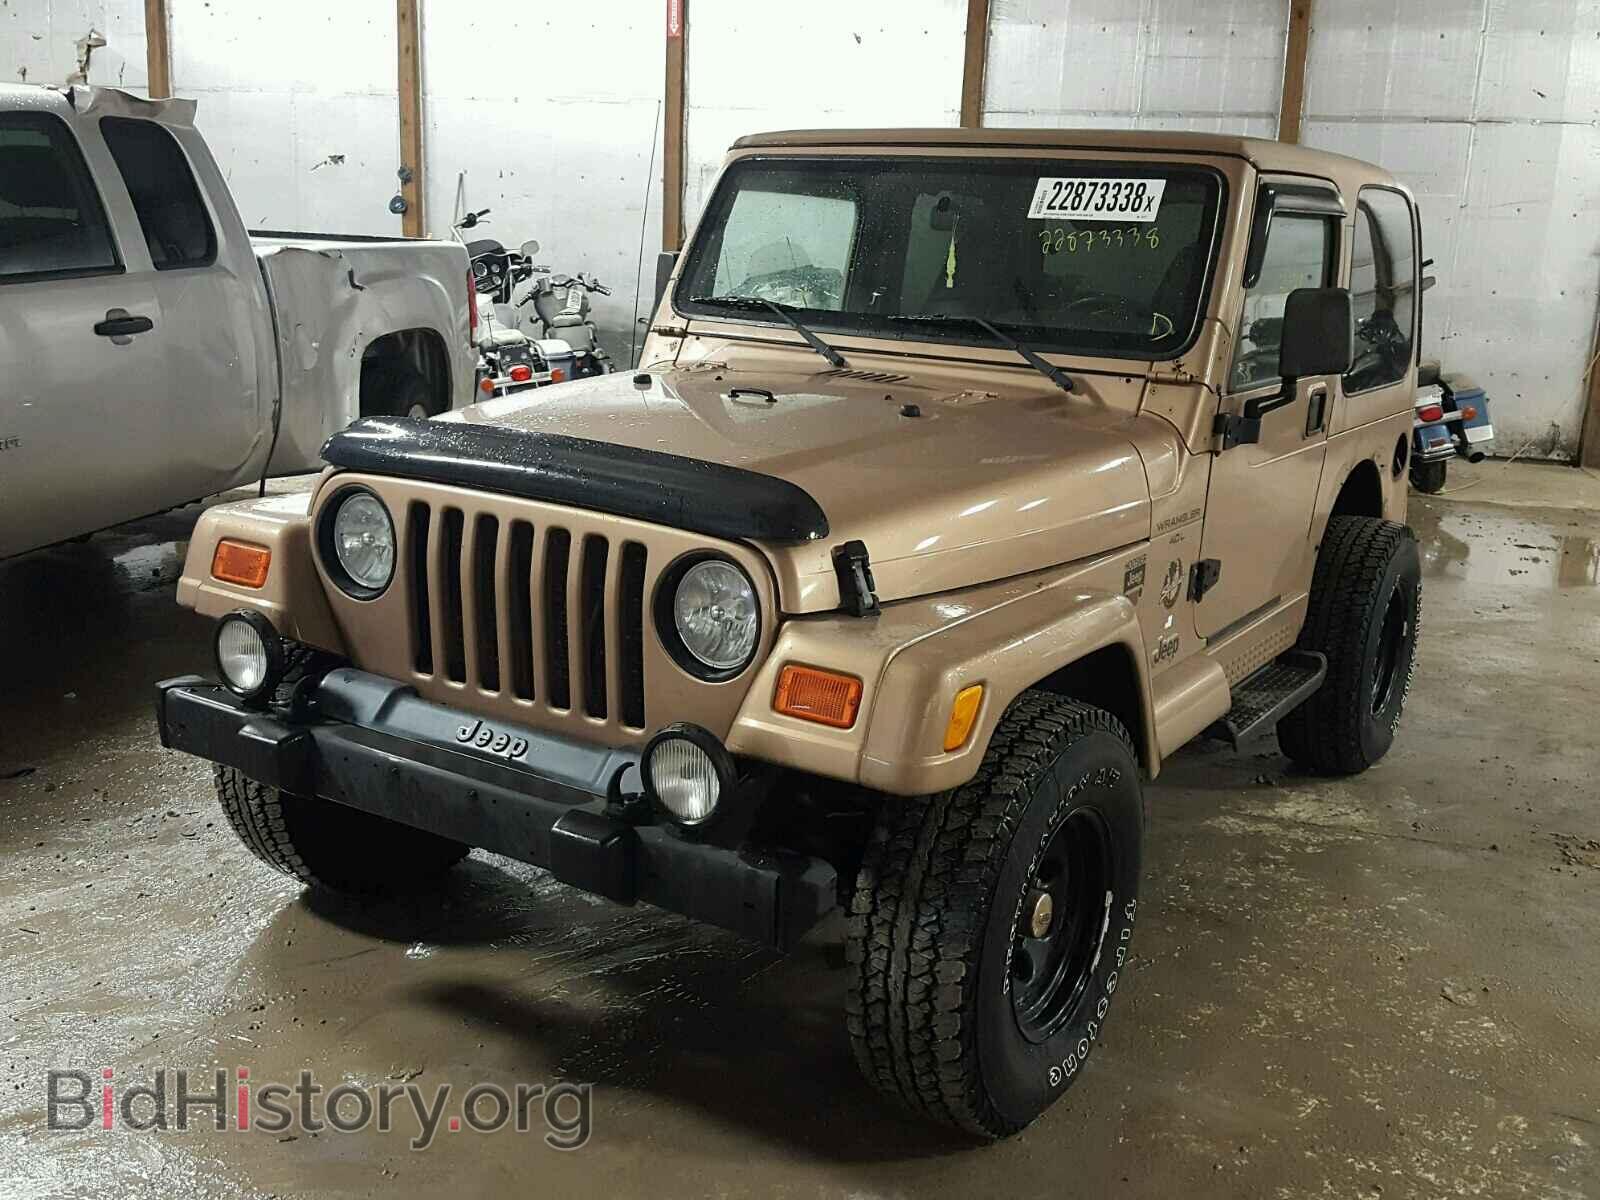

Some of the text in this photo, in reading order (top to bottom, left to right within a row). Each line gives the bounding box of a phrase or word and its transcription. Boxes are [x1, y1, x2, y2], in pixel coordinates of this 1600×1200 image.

[1039, 225, 1159, 254] 22873338
[1156, 508, 1201, 531] WRANGLER
[1152, 634, 1179, 664] Jeep
[455, 719, 529, 761] Jeep
